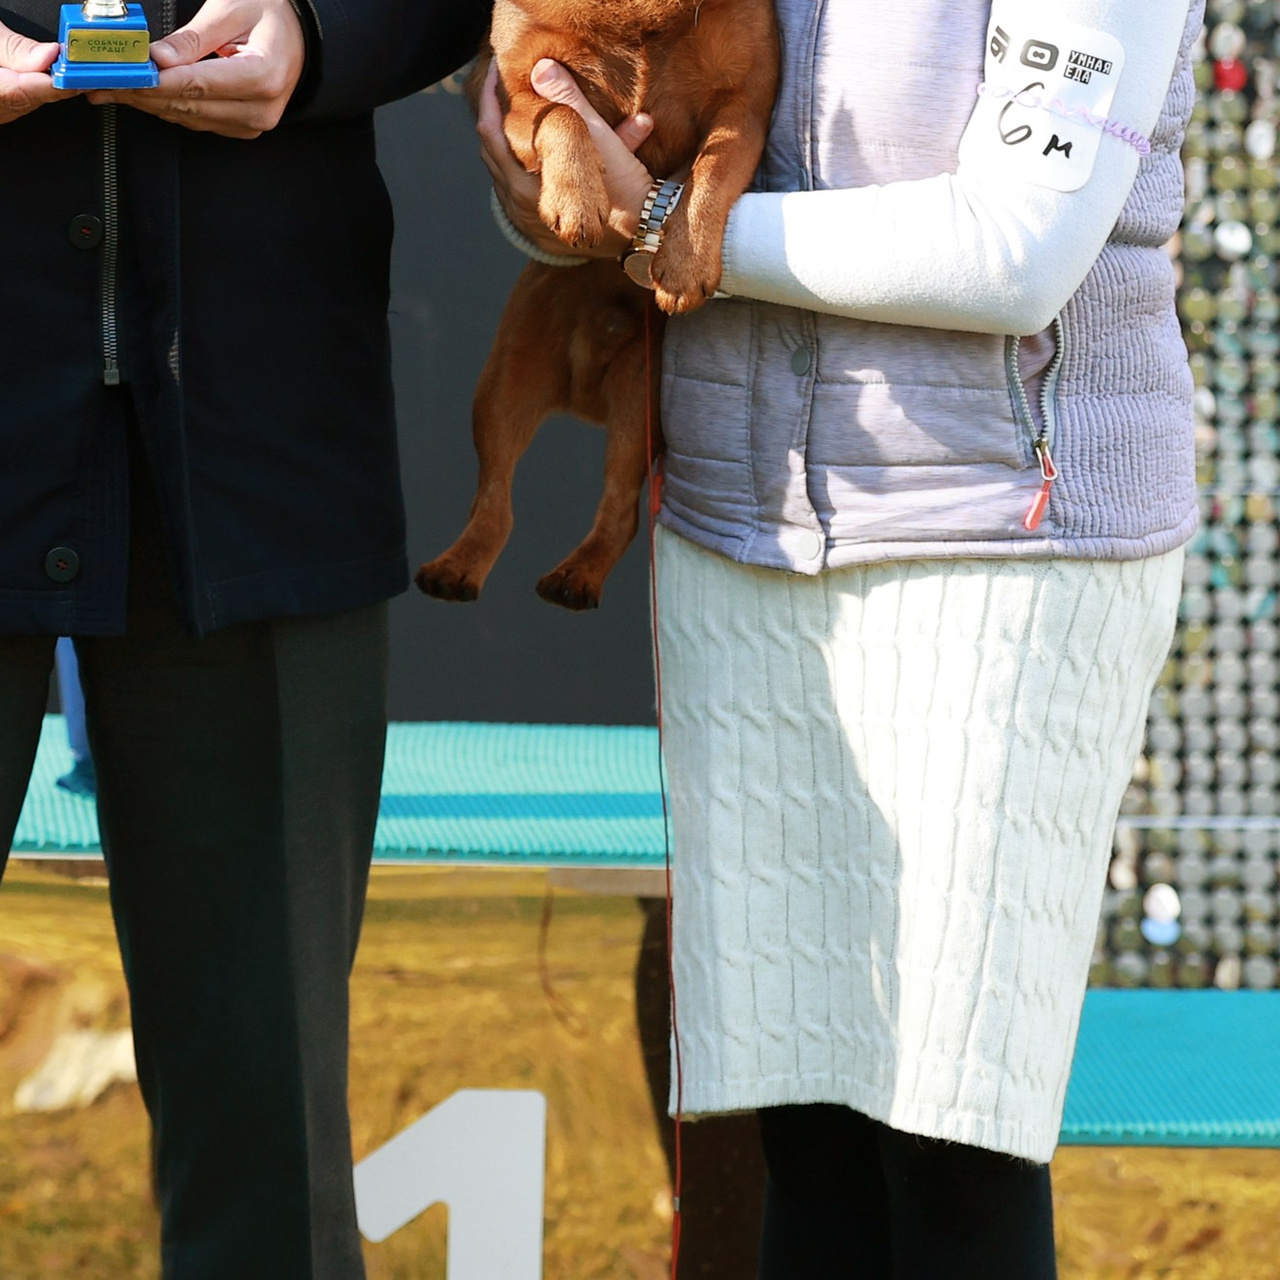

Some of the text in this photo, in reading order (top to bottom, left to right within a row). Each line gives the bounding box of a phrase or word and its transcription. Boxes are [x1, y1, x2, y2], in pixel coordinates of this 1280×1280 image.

[1065, 65, 1091, 84] ЕДА
[1070, 50, 1112, 74] УМНАЯ
[998, 82, 1045, 145] 6
[353, 1088, 547, 1280] 1
